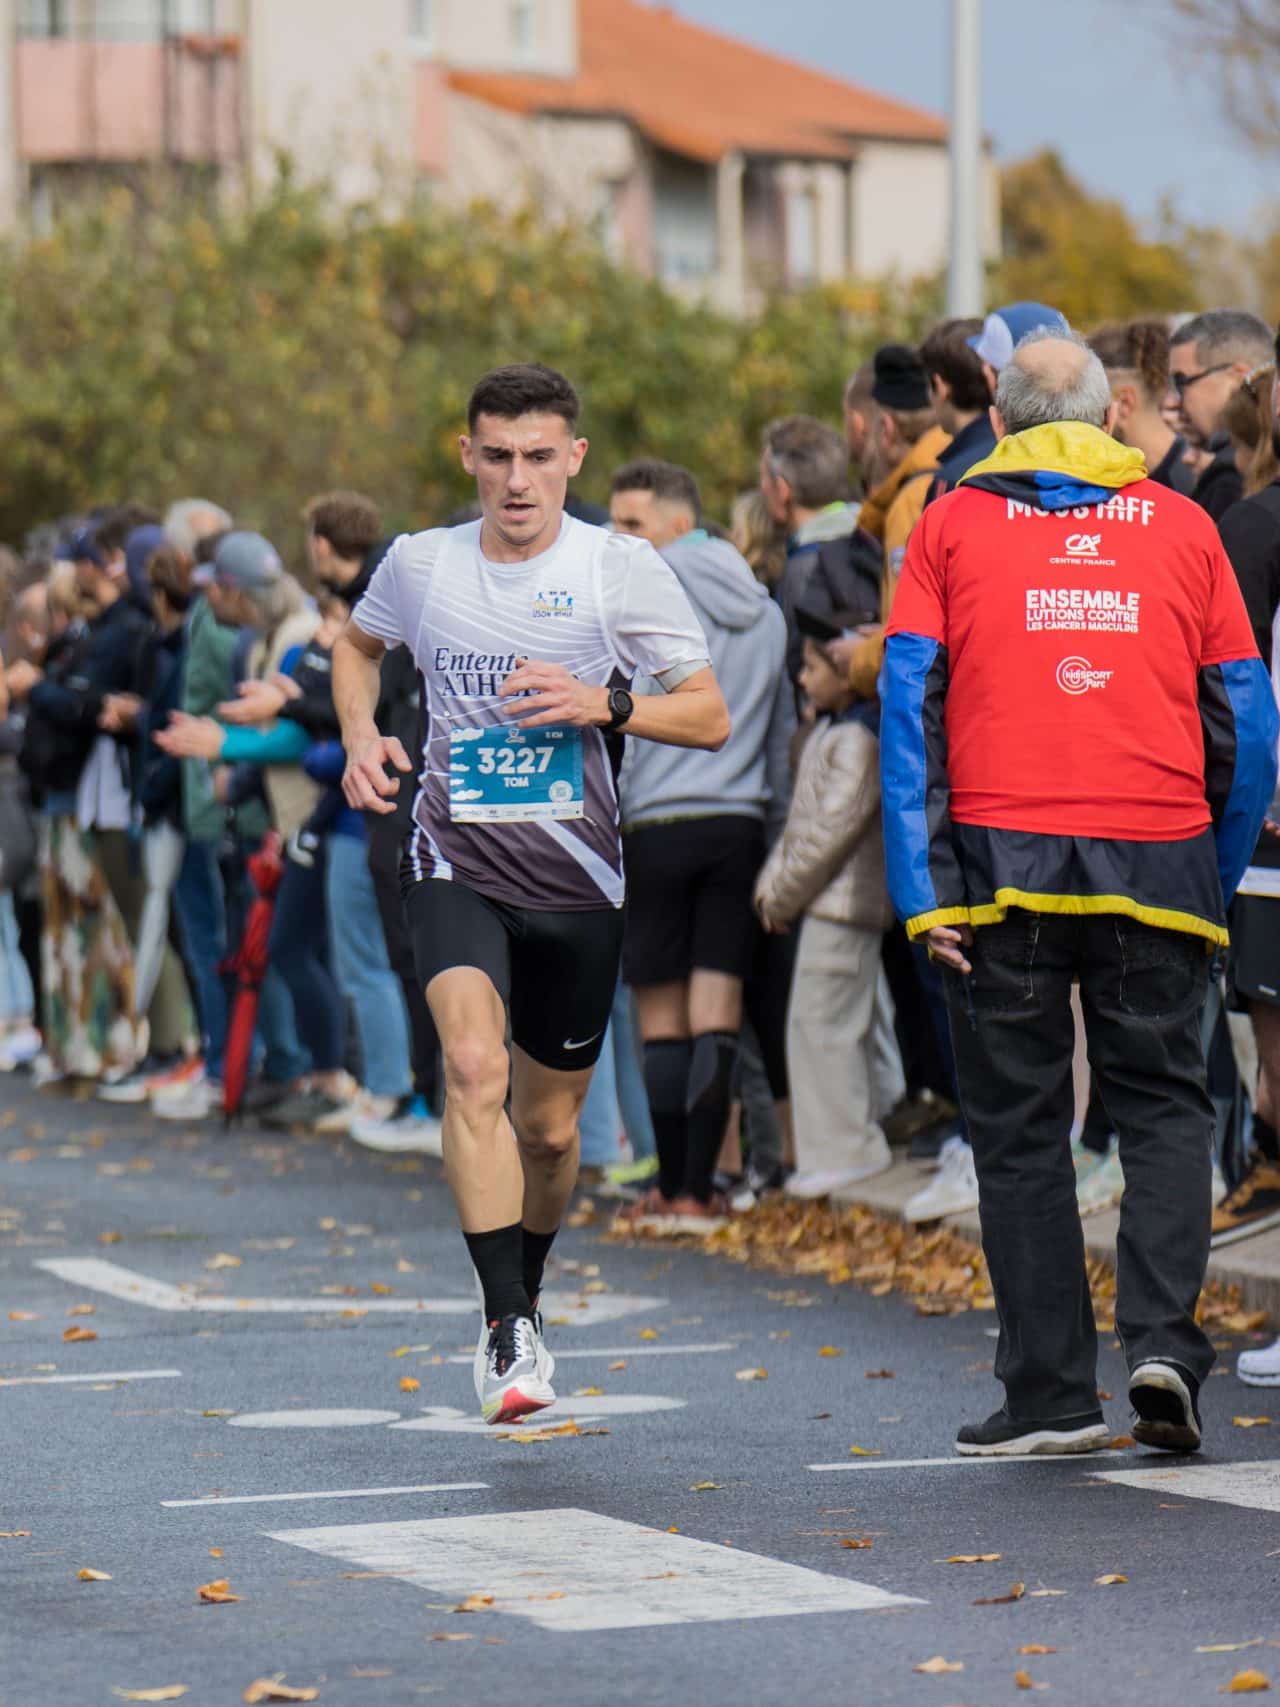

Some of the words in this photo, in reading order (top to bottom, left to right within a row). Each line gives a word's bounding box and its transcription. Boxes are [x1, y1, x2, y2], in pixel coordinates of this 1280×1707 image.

[1049, 557, 1081, 565] CENTRE
[1083, 558, 1116, 566] FRANCE
[1025, 589, 1140, 611] ENSEMBLE
[1026, 609, 1085, 621] LUTTONS
[1087, 609, 1138, 624] CONTRE
[1026, 621, 1043, 631] LES
[1044, 621, 1087, 631] CANCERS
[1087, 622, 1139, 633] MASCULINS
[477, 746, 555, 774] 3227
[503, 776, 529, 788] TOM
